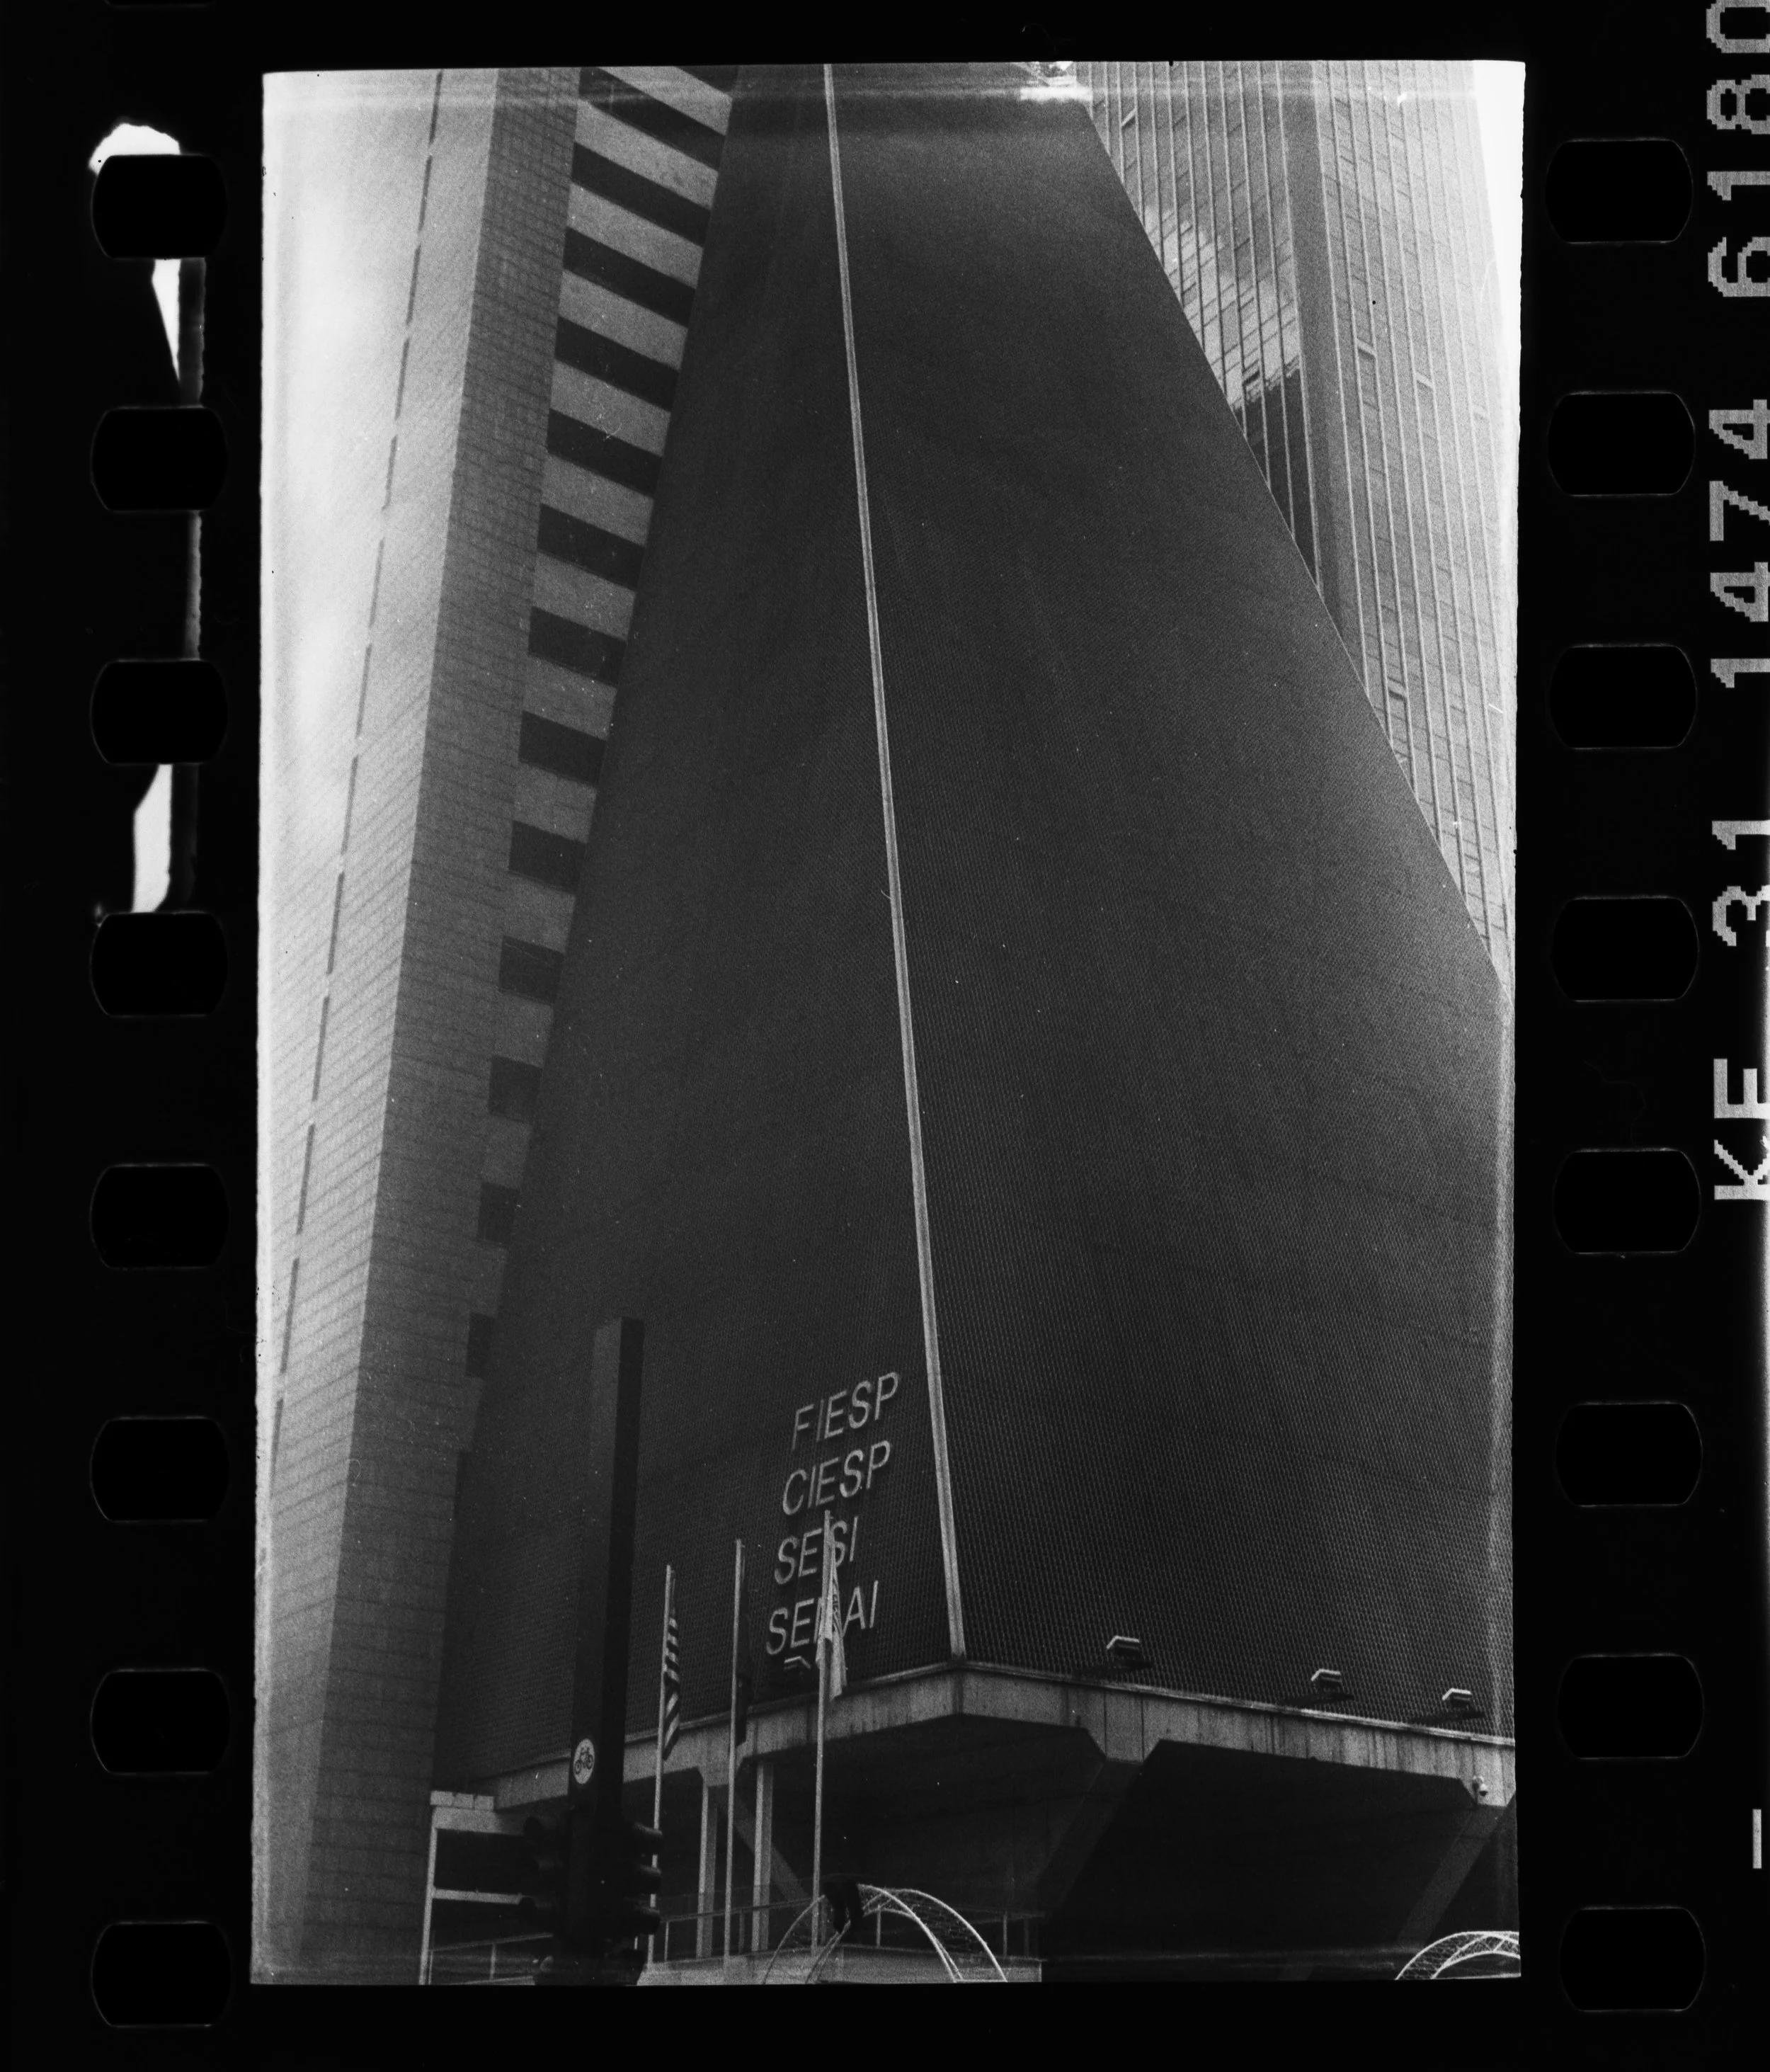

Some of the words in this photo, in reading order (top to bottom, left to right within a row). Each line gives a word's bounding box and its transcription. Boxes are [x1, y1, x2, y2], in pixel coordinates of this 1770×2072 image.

[1706, 0, 1770, 297] 6180
[1708, 399, 1770, 688] 1474
[1712, 819, 1770, 946] 31
[792, 1371, 899, 1450] FIESP
[782, 1440, 891, 1515] CIESP
[774, 1515, 858, 1585] SESI
